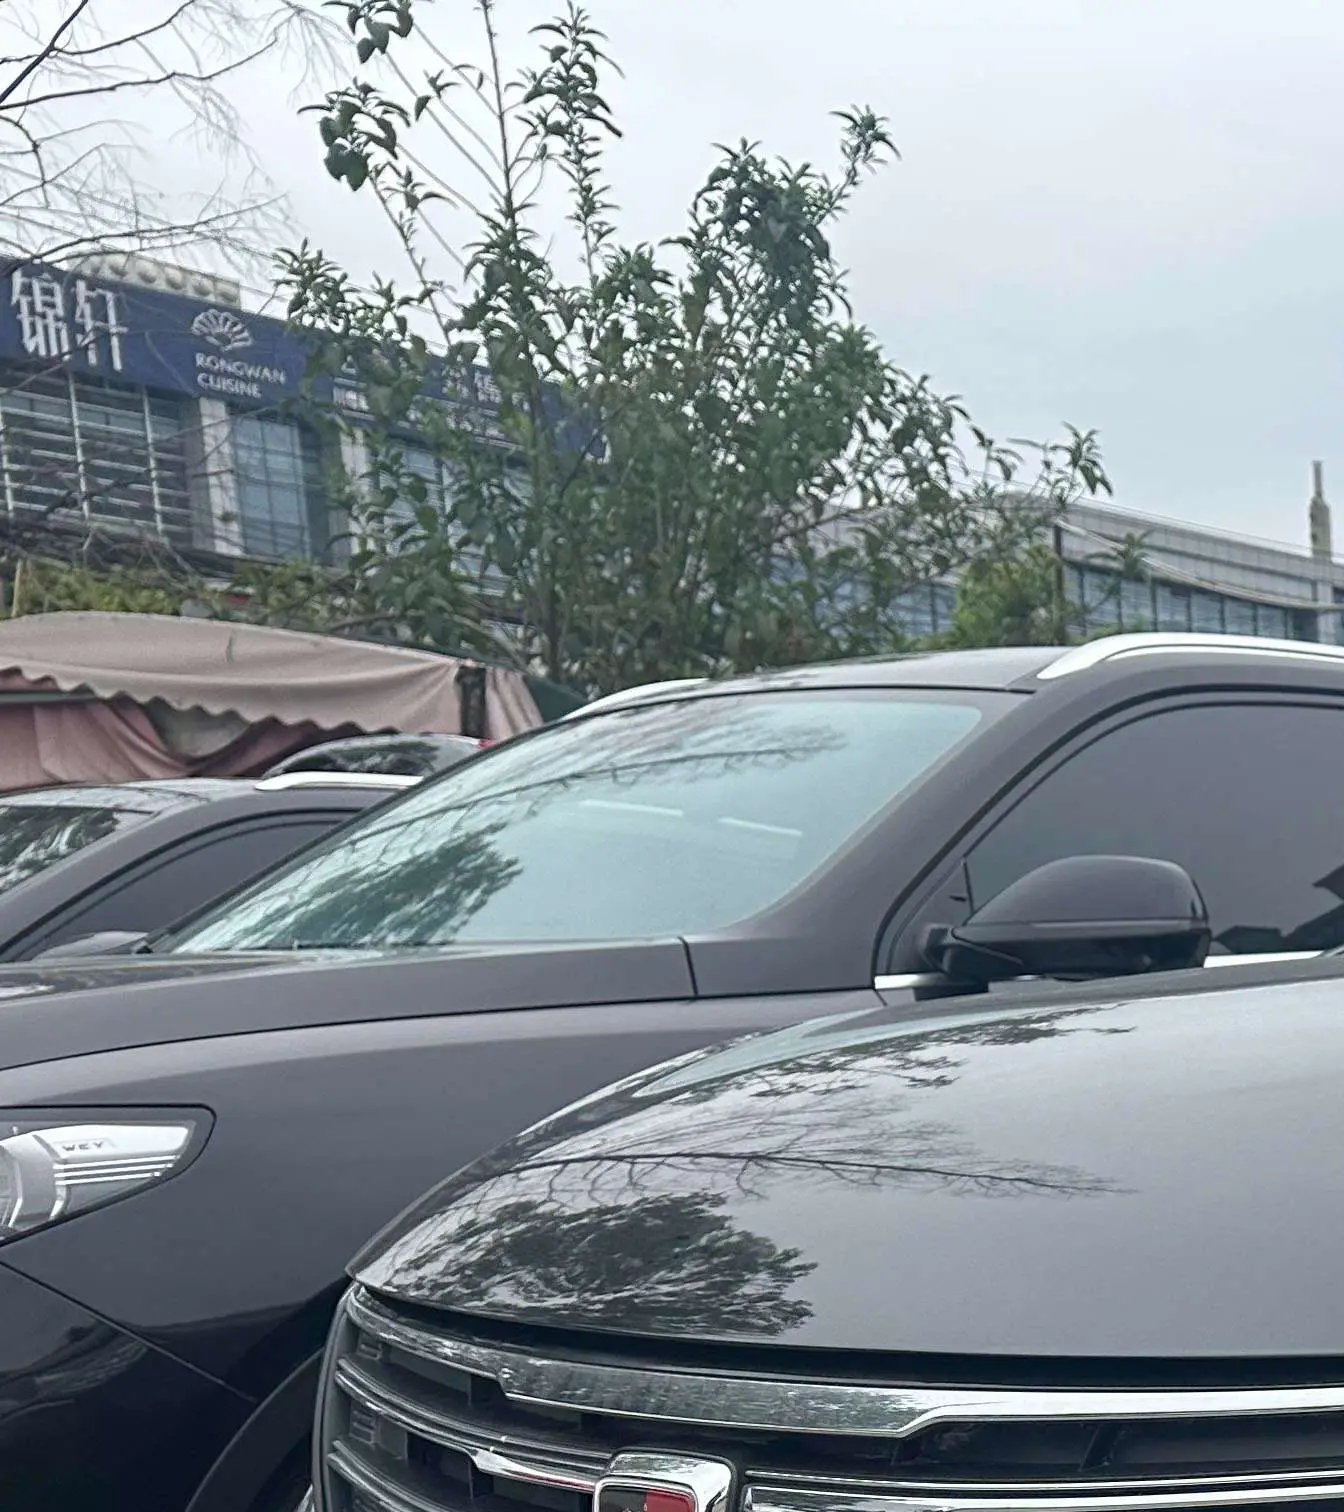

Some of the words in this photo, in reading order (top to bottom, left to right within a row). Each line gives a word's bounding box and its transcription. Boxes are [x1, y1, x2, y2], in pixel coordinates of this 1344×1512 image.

[195, 352, 287, 386] RONGWAN
[197, 372, 262, 399] CUISINE
[62, 1140, 104, 1151] WEY
